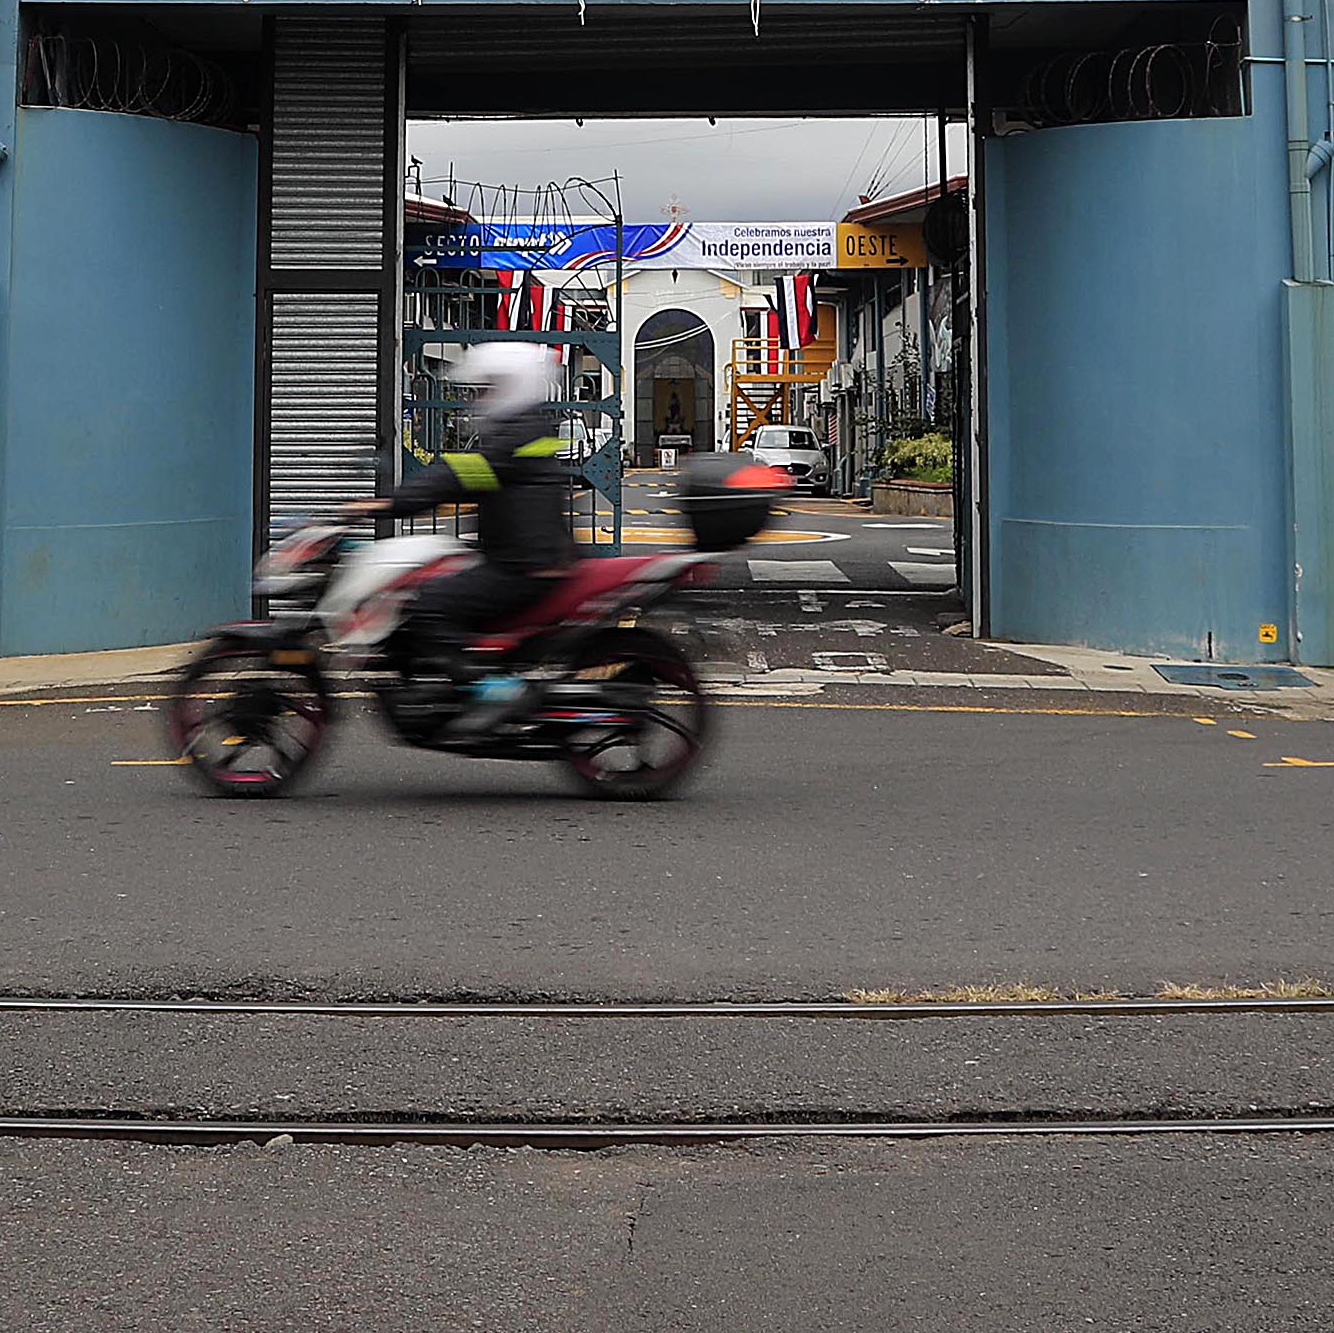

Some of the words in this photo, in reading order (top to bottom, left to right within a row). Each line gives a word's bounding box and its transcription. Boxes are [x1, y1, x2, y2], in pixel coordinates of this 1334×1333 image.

[734, 227, 792, 237] Celebramos
[794, 227, 831, 237] nuestra
[702, 239, 831, 259] Independencia
[846, 235, 898, 256] OESTE
